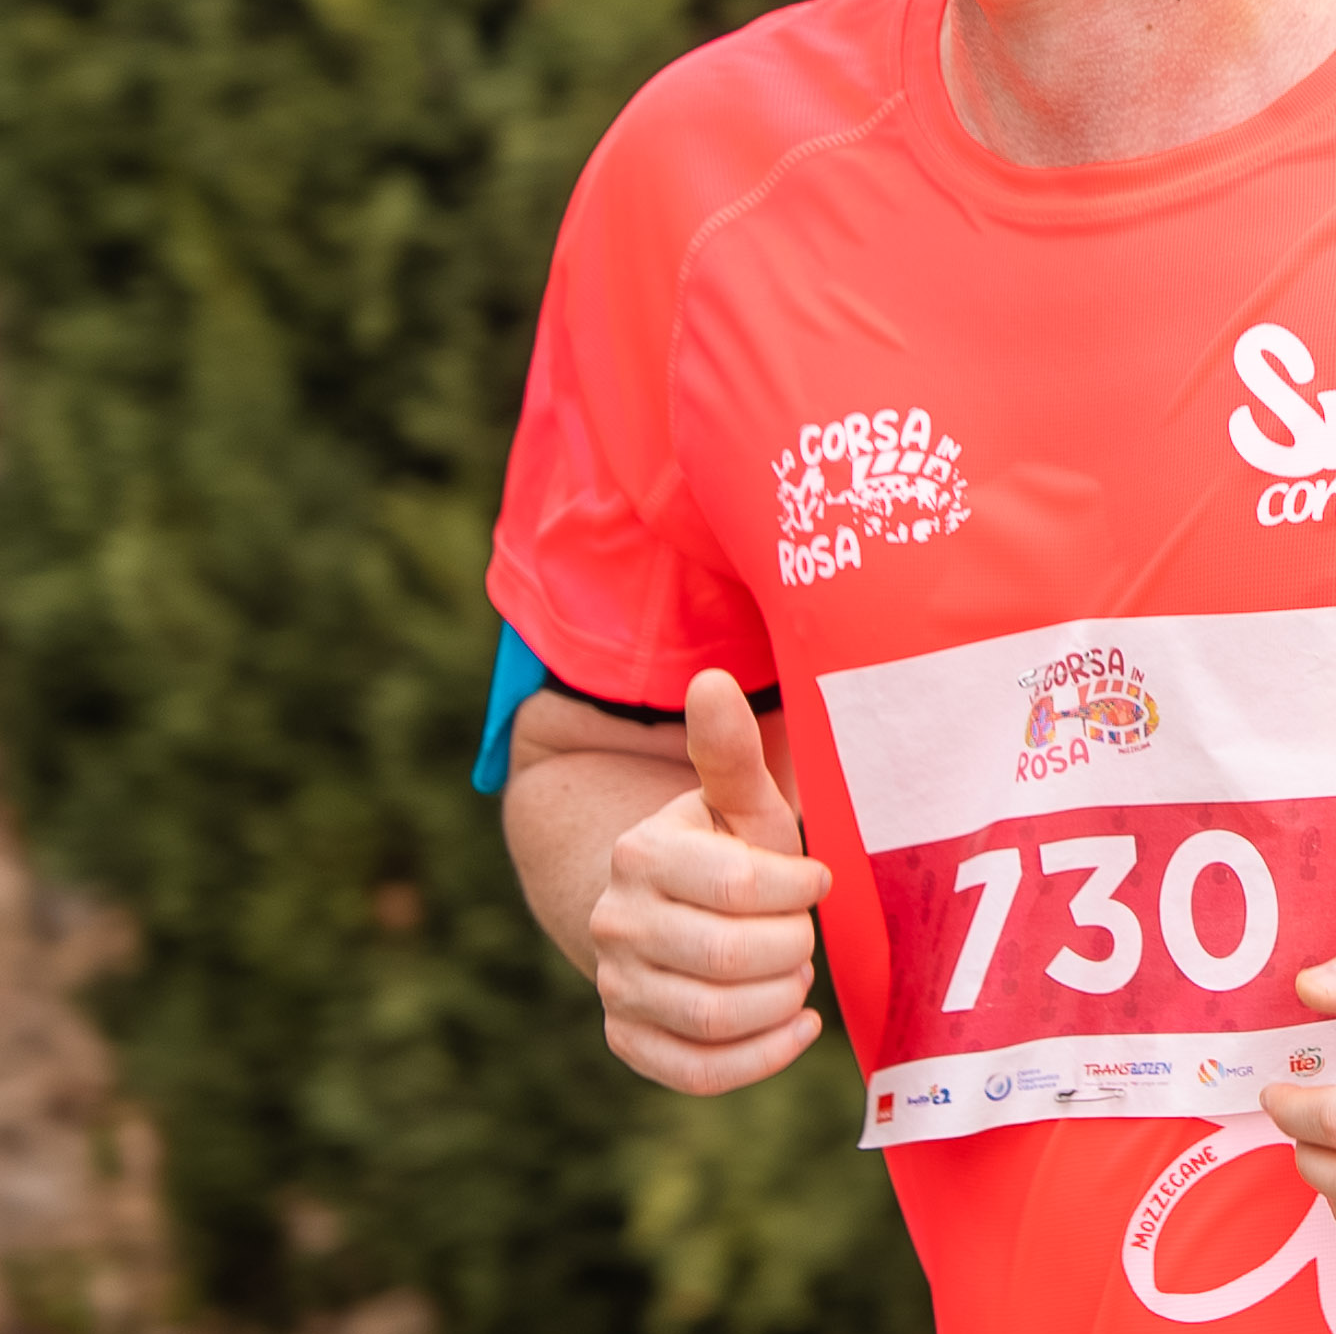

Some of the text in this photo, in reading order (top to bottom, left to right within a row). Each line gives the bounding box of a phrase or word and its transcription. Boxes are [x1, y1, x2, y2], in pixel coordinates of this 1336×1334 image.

[799, 406, 931, 466] CORSA
[936, 434, 962, 462] IN
[777, 525, 862, 586] ROSA
[1042, 646, 1125, 693] CORSA
[1130, 666, 1146, 684] IN
[1015, 736, 1090, 783] ROSA
[941, 828, 1279, 1013] 730
[1226, 1065, 1255, 1078] MGR
[1130, 1145, 1218, 1251] MOZZECANE
